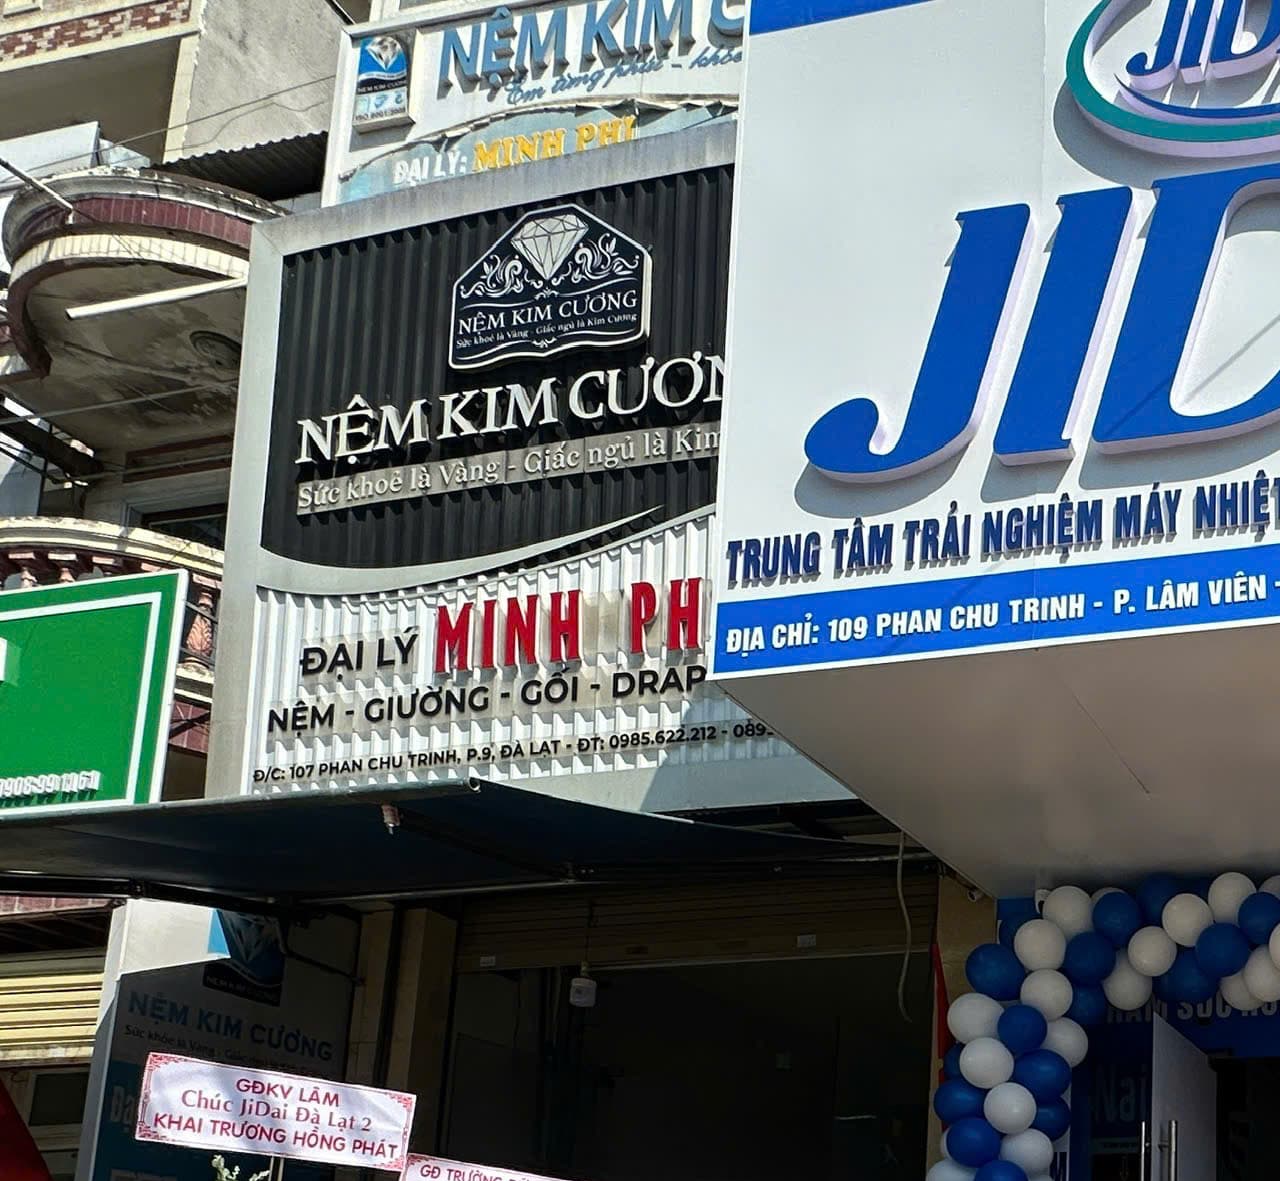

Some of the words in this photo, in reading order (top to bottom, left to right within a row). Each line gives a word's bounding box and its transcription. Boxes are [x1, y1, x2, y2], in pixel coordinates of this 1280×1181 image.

[440, 7, 568, 86] NỆM
[588, 0, 695, 58] KIM
[473, 128, 566, 172] MINH
[458, 312, 505, 335] NỆM
[512, 305, 552, 326] KIM
[559, 290, 638, 318] CƯƠNG
[295, 394, 431, 465] NỆM
[436, 376, 562, 441] KIM
[298, 482, 340, 509] Sức
[410, 464, 431, 491] là
[441, 458, 500, 488] Vàng
[524, 441, 580, 474] Giấc
[588, 437, 635, 467] ngủ
[643, 431, 667, 457] là
[727, 531, 822, 584] TRUNG
[833, 517, 894, 572] TÂM
[905, 500, 972, 564] TRẢI
[983, 493, 1103, 558] NGHIỆM
[1115, 482, 1182, 541] MÁY
[300, 640, 364, 681] ĐẠI
[376, 626, 420, 667] LÝ
[435, 588, 582, 674] MINH
[726, 628, 764, 658] ĐỊA
[771, 613, 819, 648] CHỈ:
[828, 615, 869, 643] 109
[876, 607, 942, 638] PHAN
[950, 602, 999, 630] CHU
[1009, 594, 1085, 624] TRINH
[1113, 589, 1136, 615] P.
[1145, 579, 1199, 612] LÂM
[1208, 571, 1267, 606] VIÊN
[268, 700, 335, 737] NỆM
[364, 684, 490, 723] GIƯỜNG
[521, 666, 578, 706] GỐI
[612, 664, 707, 699] DRAP
[253, 767, 286, 783] Đ/C:
[290, 764, 313, 779] 107
[318, 759, 363, 777] PHAN
[368, 755, 403, 771] CHU
[409, 750, 462, 769] TRINH,
[467, 748, 496, 762] P.9,
[501, 740, 525, 759] ĐÀ
[530, 739, 561, 760] LẠT
[577, 736, 605, 754] ĐT:
[609, 725, 717, 749] 0985.622.212
[181, 1089, 235, 1113] Chúc
[239, 1099, 289, 1120] JiDai
[295, 1106, 321, 1126] Đà
[328, 1112, 356, 1131] Lạt
[360, 1117, 372, 1133] 2
[236, 1078, 293, 1099] GĐKV
[153, 1113, 202, 1134] KHAI
[209, 1119, 287, 1144] TRƯƠNG
[293, 1120, 347, 1153] HỒNG
[351, 1134, 399, 1159] PHÁT
[420, 1164, 441, 1178] GĐ
